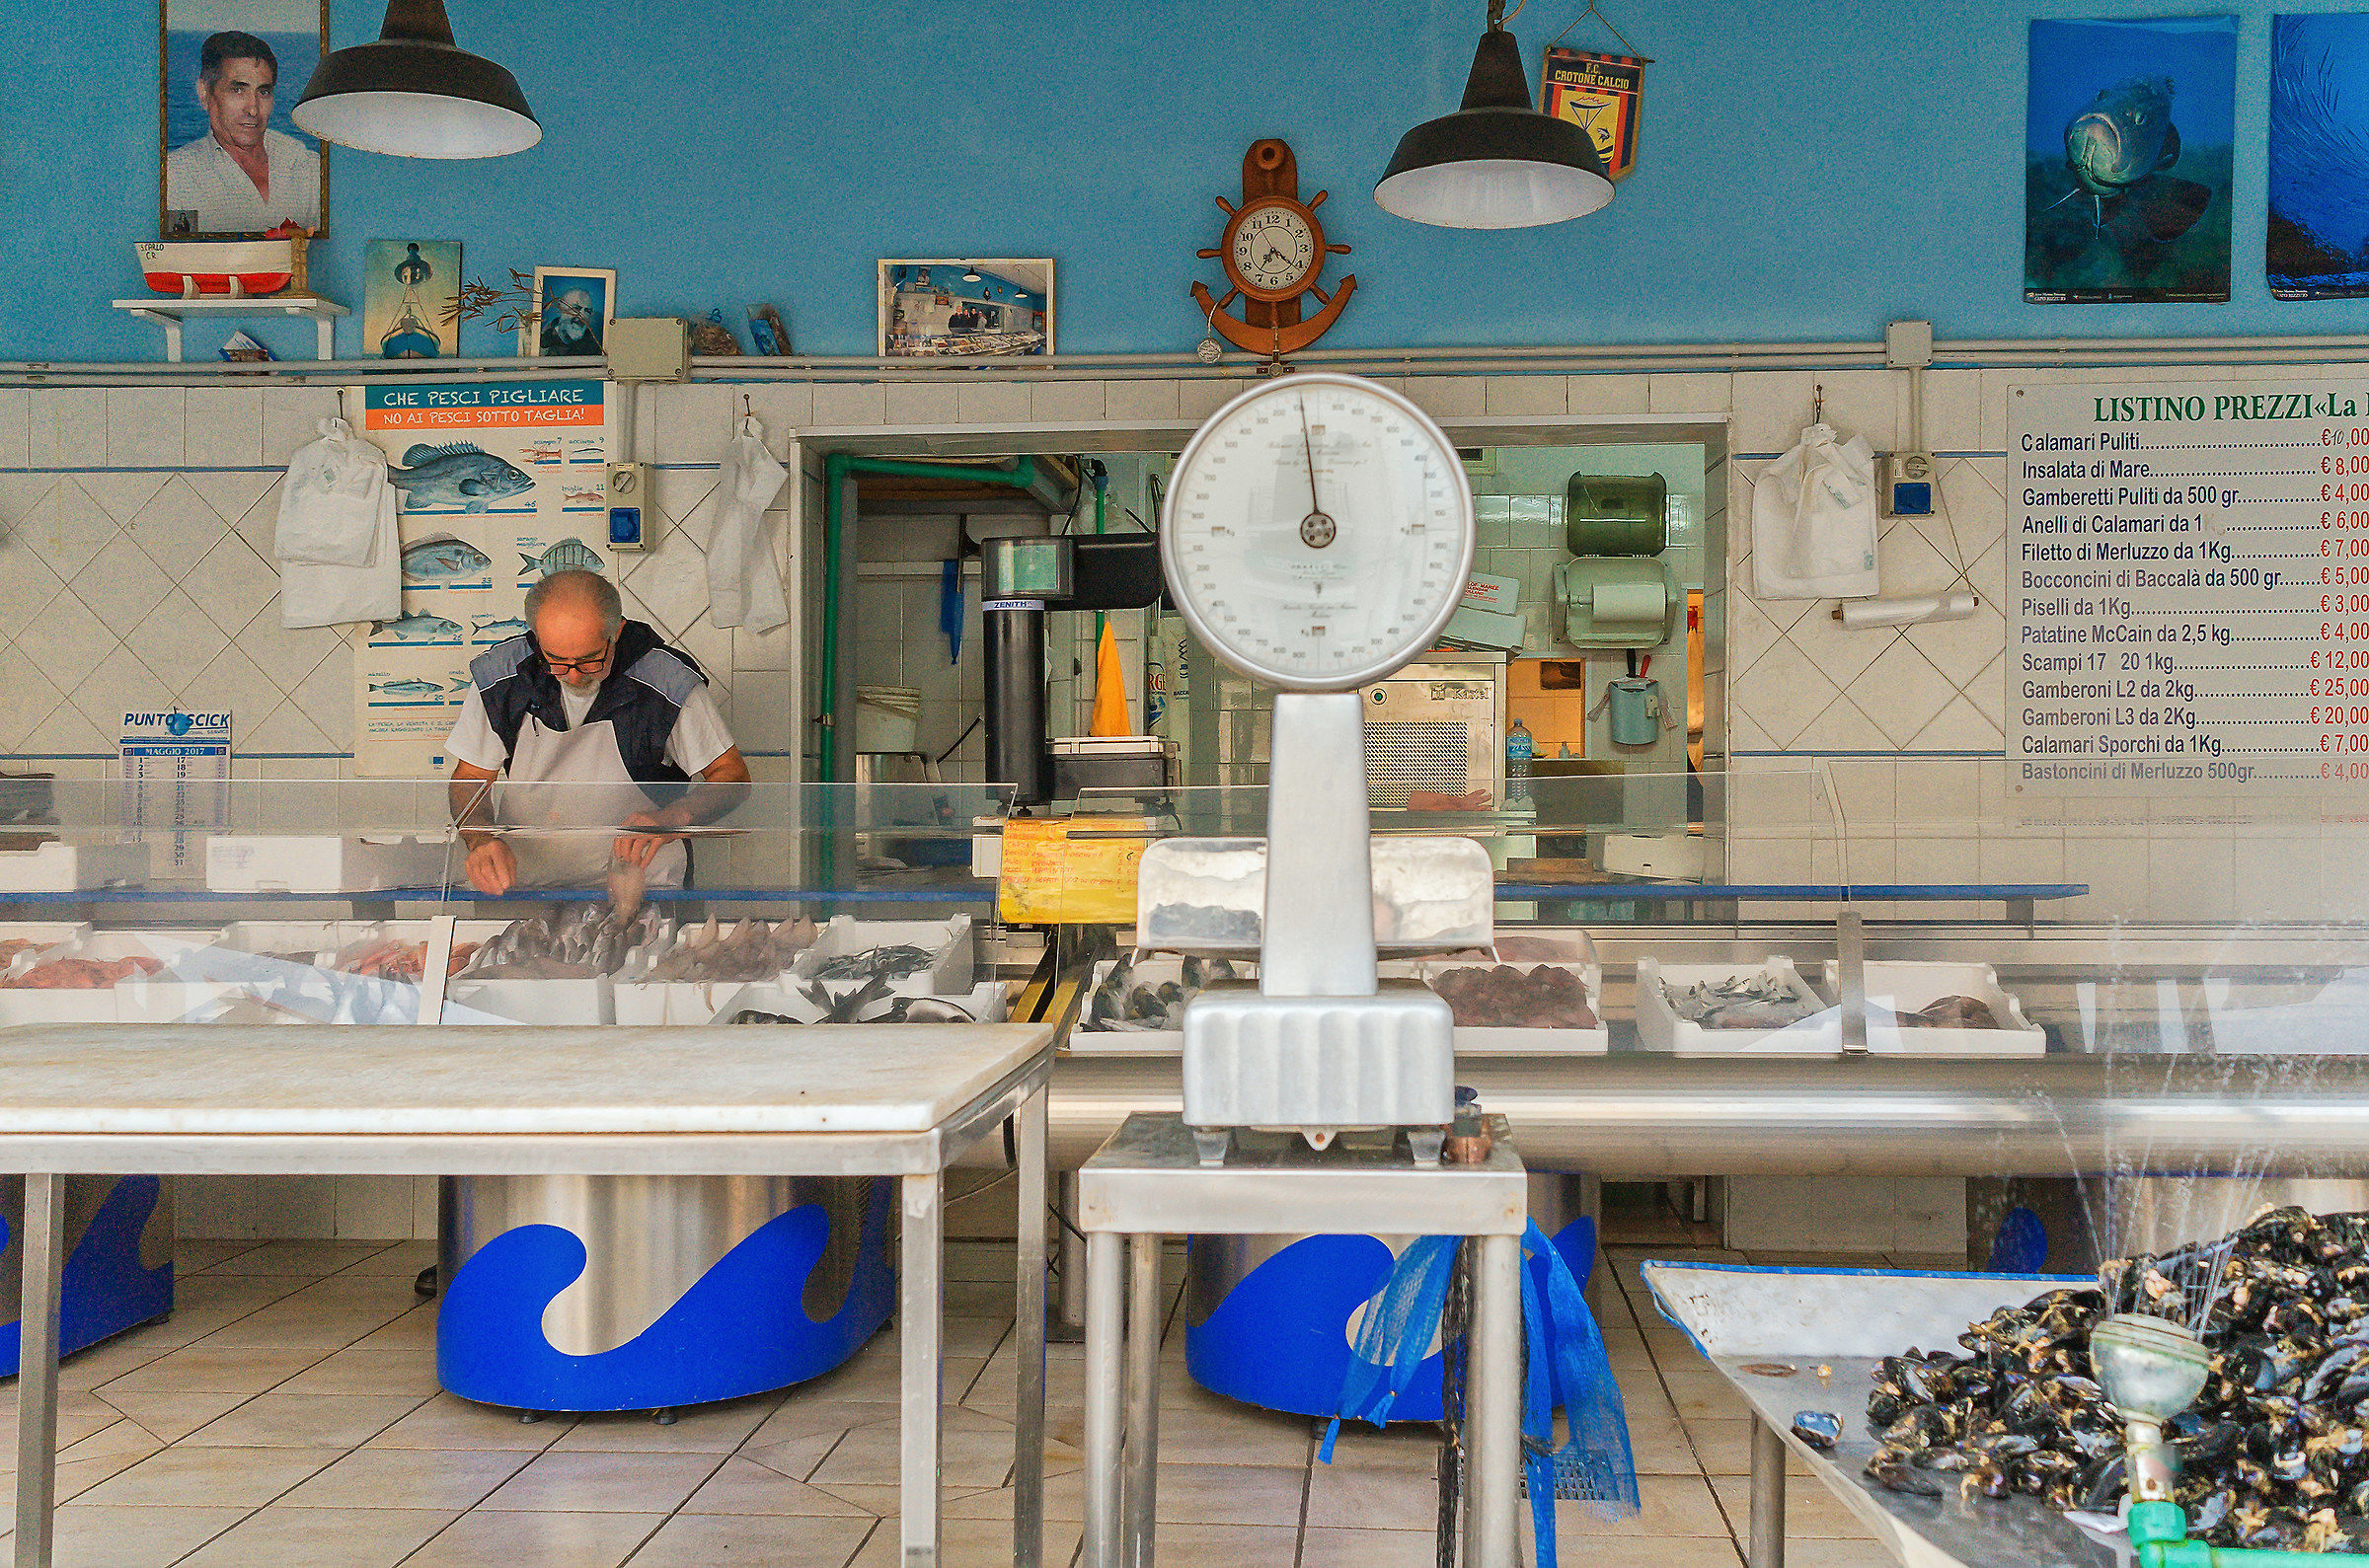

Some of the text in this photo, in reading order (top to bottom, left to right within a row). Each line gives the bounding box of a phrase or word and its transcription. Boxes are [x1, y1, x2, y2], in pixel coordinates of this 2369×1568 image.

[1586, 63, 1600, 74] F.C.
[1555, 70, 1629, 90] CROTONE CALCIO
[1252, 220, 1262, 229] 11
[1239, 247, 1248, 256] 9
[1299, 244, 1309, 253] 3
[1296, 260, 1304, 268] 4
[384, 389, 584, 406] CHE PESCI PIGLIARE
[384, 409, 585, 424] NO AI PESCI SOTTO TAGLIA!
[2093, 396, 2206, 422] LISTINO
[2022, 433, 2095, 451] Calamari
[2101, 432, 2139, 450] Puliti
[2024, 456, 2369, 479] Insalata di Mare € 8,00
[2024, 487, 2113, 505] Gamberetti
[2119, 487, 2158, 504] Puliti
[2164, 486, 2182, 504] da
[2188, 486, 2216, 503] 500
[2321, 484, 2331, 501] €
[2335, 484, 2369, 504] 4,00
[2023, 516, 2067, 534] Anelli
[2073, 516, 2086, 533] di
[2093, 515, 2164, 533] Calamari
[2170, 514, 2189, 532] da
[2321, 512, 2331, 529] €
[2337, 511, 2369, 532] 6,00
[2023, 539, 2369, 563] Filetto di Merluzzo da 1Kg € 7,00
[2023, 570, 2110, 588] Bocconcini
[2116, 570, 2130, 587] di
[2136, 569, 2200, 586] Baccalà
[2205, 568, 2225, 586] da
[2231, 568, 2258, 586] 500
[2321, 567, 2331, 584] €
[2335, 566, 2369, 588] 5,00
[2023, 595, 2369, 619] Piselli da 1Kg € 3,00
[2023, 623, 2369, 646] Patatine McCain da 2,5 kg € 4,00
[2023, 651, 2369, 675] Scampi 17 20 1kg € 12,00
[1452, 687, 1490, 700] Kastel
[2023, 678, 2369, 702] Gamberoni L2 da 2kg € 25,00
[124, 713, 230, 727] PUNTO SCICK
[2023, 707, 2369, 729] Gamberoni L3 da 2Kg € 20,00
[2023, 734, 2369, 757] Calamari Sporchi da 1Kg € 7,00
[2022, 762, 2105, 779] Bastoncini
[2110, 762, 2125, 779] di
[2132, 762, 2202, 779] Merluzzo
[2322, 763, 2330, 779] €
[2335, 763, 2369, 782] 4,00
